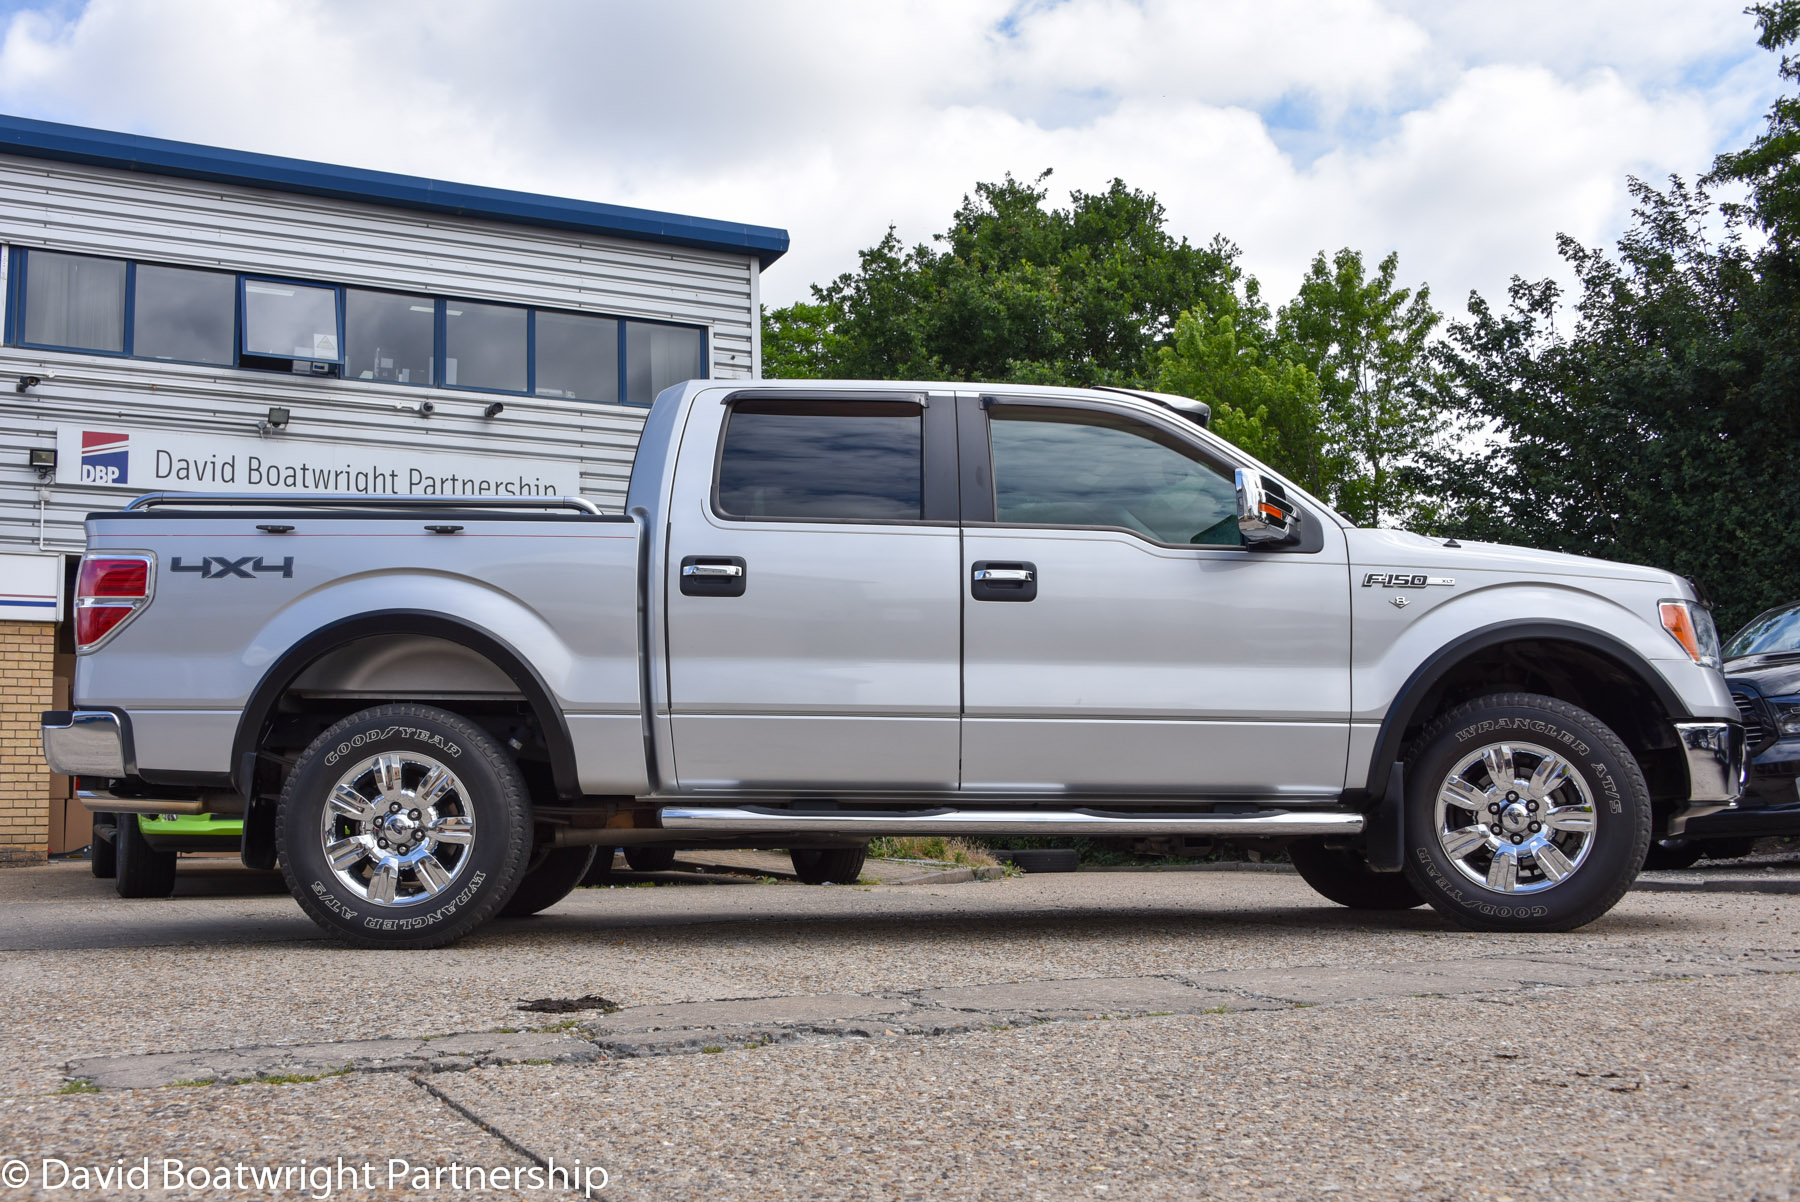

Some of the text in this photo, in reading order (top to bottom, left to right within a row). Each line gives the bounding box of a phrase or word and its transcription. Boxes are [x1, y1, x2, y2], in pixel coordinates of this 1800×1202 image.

[82, 464, 120, 484] DBP
[155, 449, 236, 484] David
[247, 456, 399, 494] Boatwright
[1362, 573, 1428, 588] F-150
[1455, 718, 1590, 757] WRANGLER
[364, 870, 487, 931] WRANGLER
